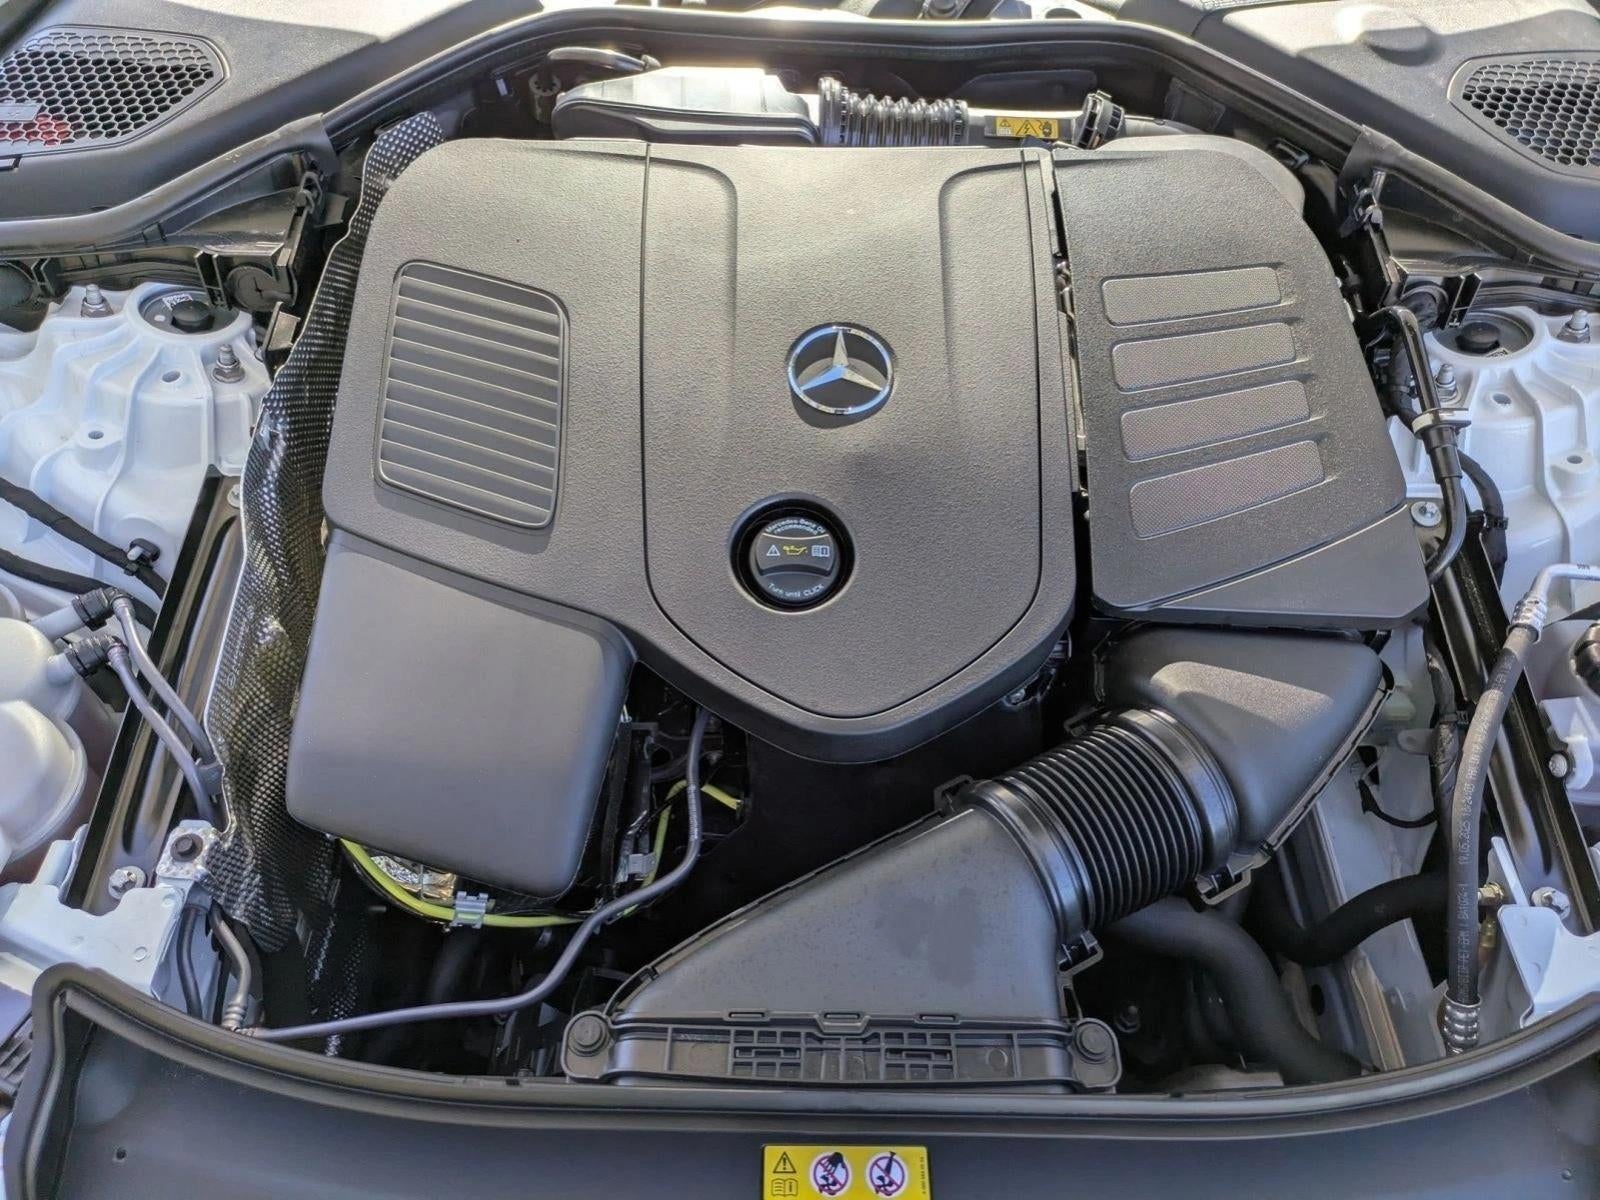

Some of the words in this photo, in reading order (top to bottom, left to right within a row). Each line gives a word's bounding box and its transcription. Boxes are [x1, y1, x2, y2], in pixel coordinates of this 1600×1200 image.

[773, 524, 818, 536] recommended
[768, 582, 784, 595] Turn
[802, 583, 825, 597] CLICK
